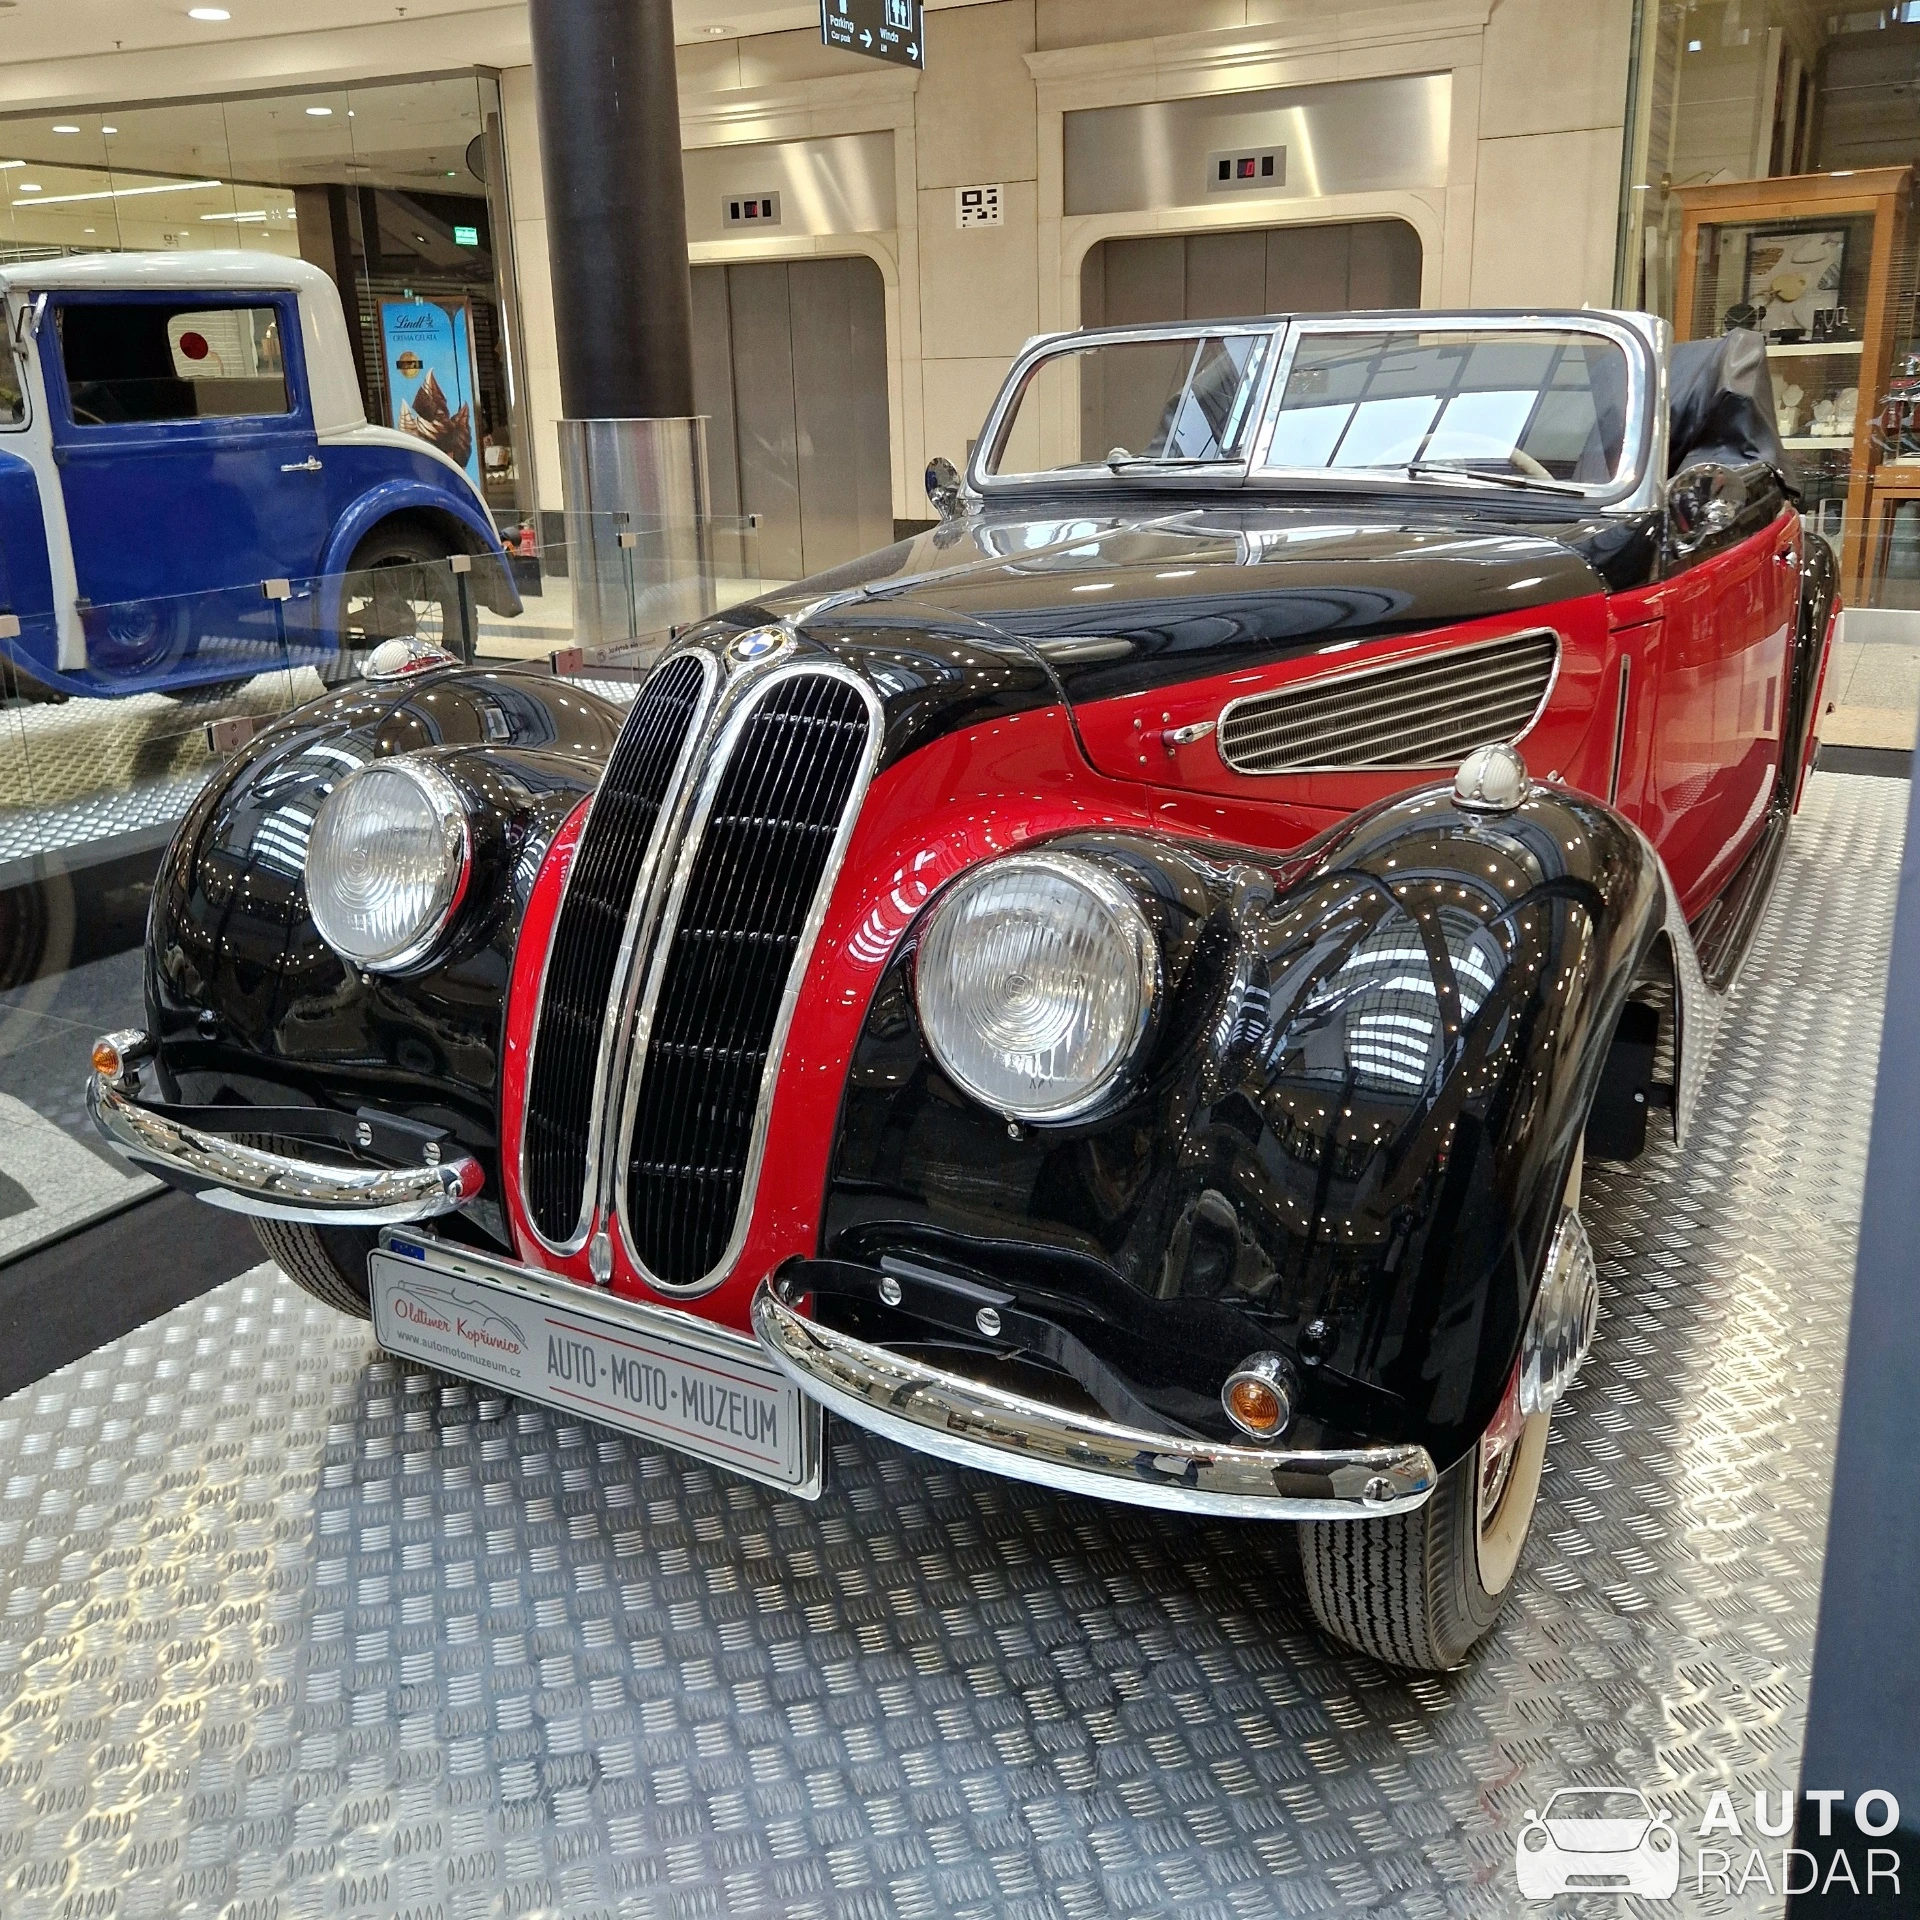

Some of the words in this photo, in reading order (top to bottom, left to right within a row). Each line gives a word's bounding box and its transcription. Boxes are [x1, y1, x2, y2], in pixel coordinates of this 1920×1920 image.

[829, 15, 854, 33] Parking
[880, 28, 899, 43] Winda
[394, 315, 425, 329] Lindt
[395, 1299, 451, 1333] Oldtimer
[456, 1317, 521, 1355] Kopřivnice
[396, 1330, 521, 1378] www.automotomuzeum.cz
